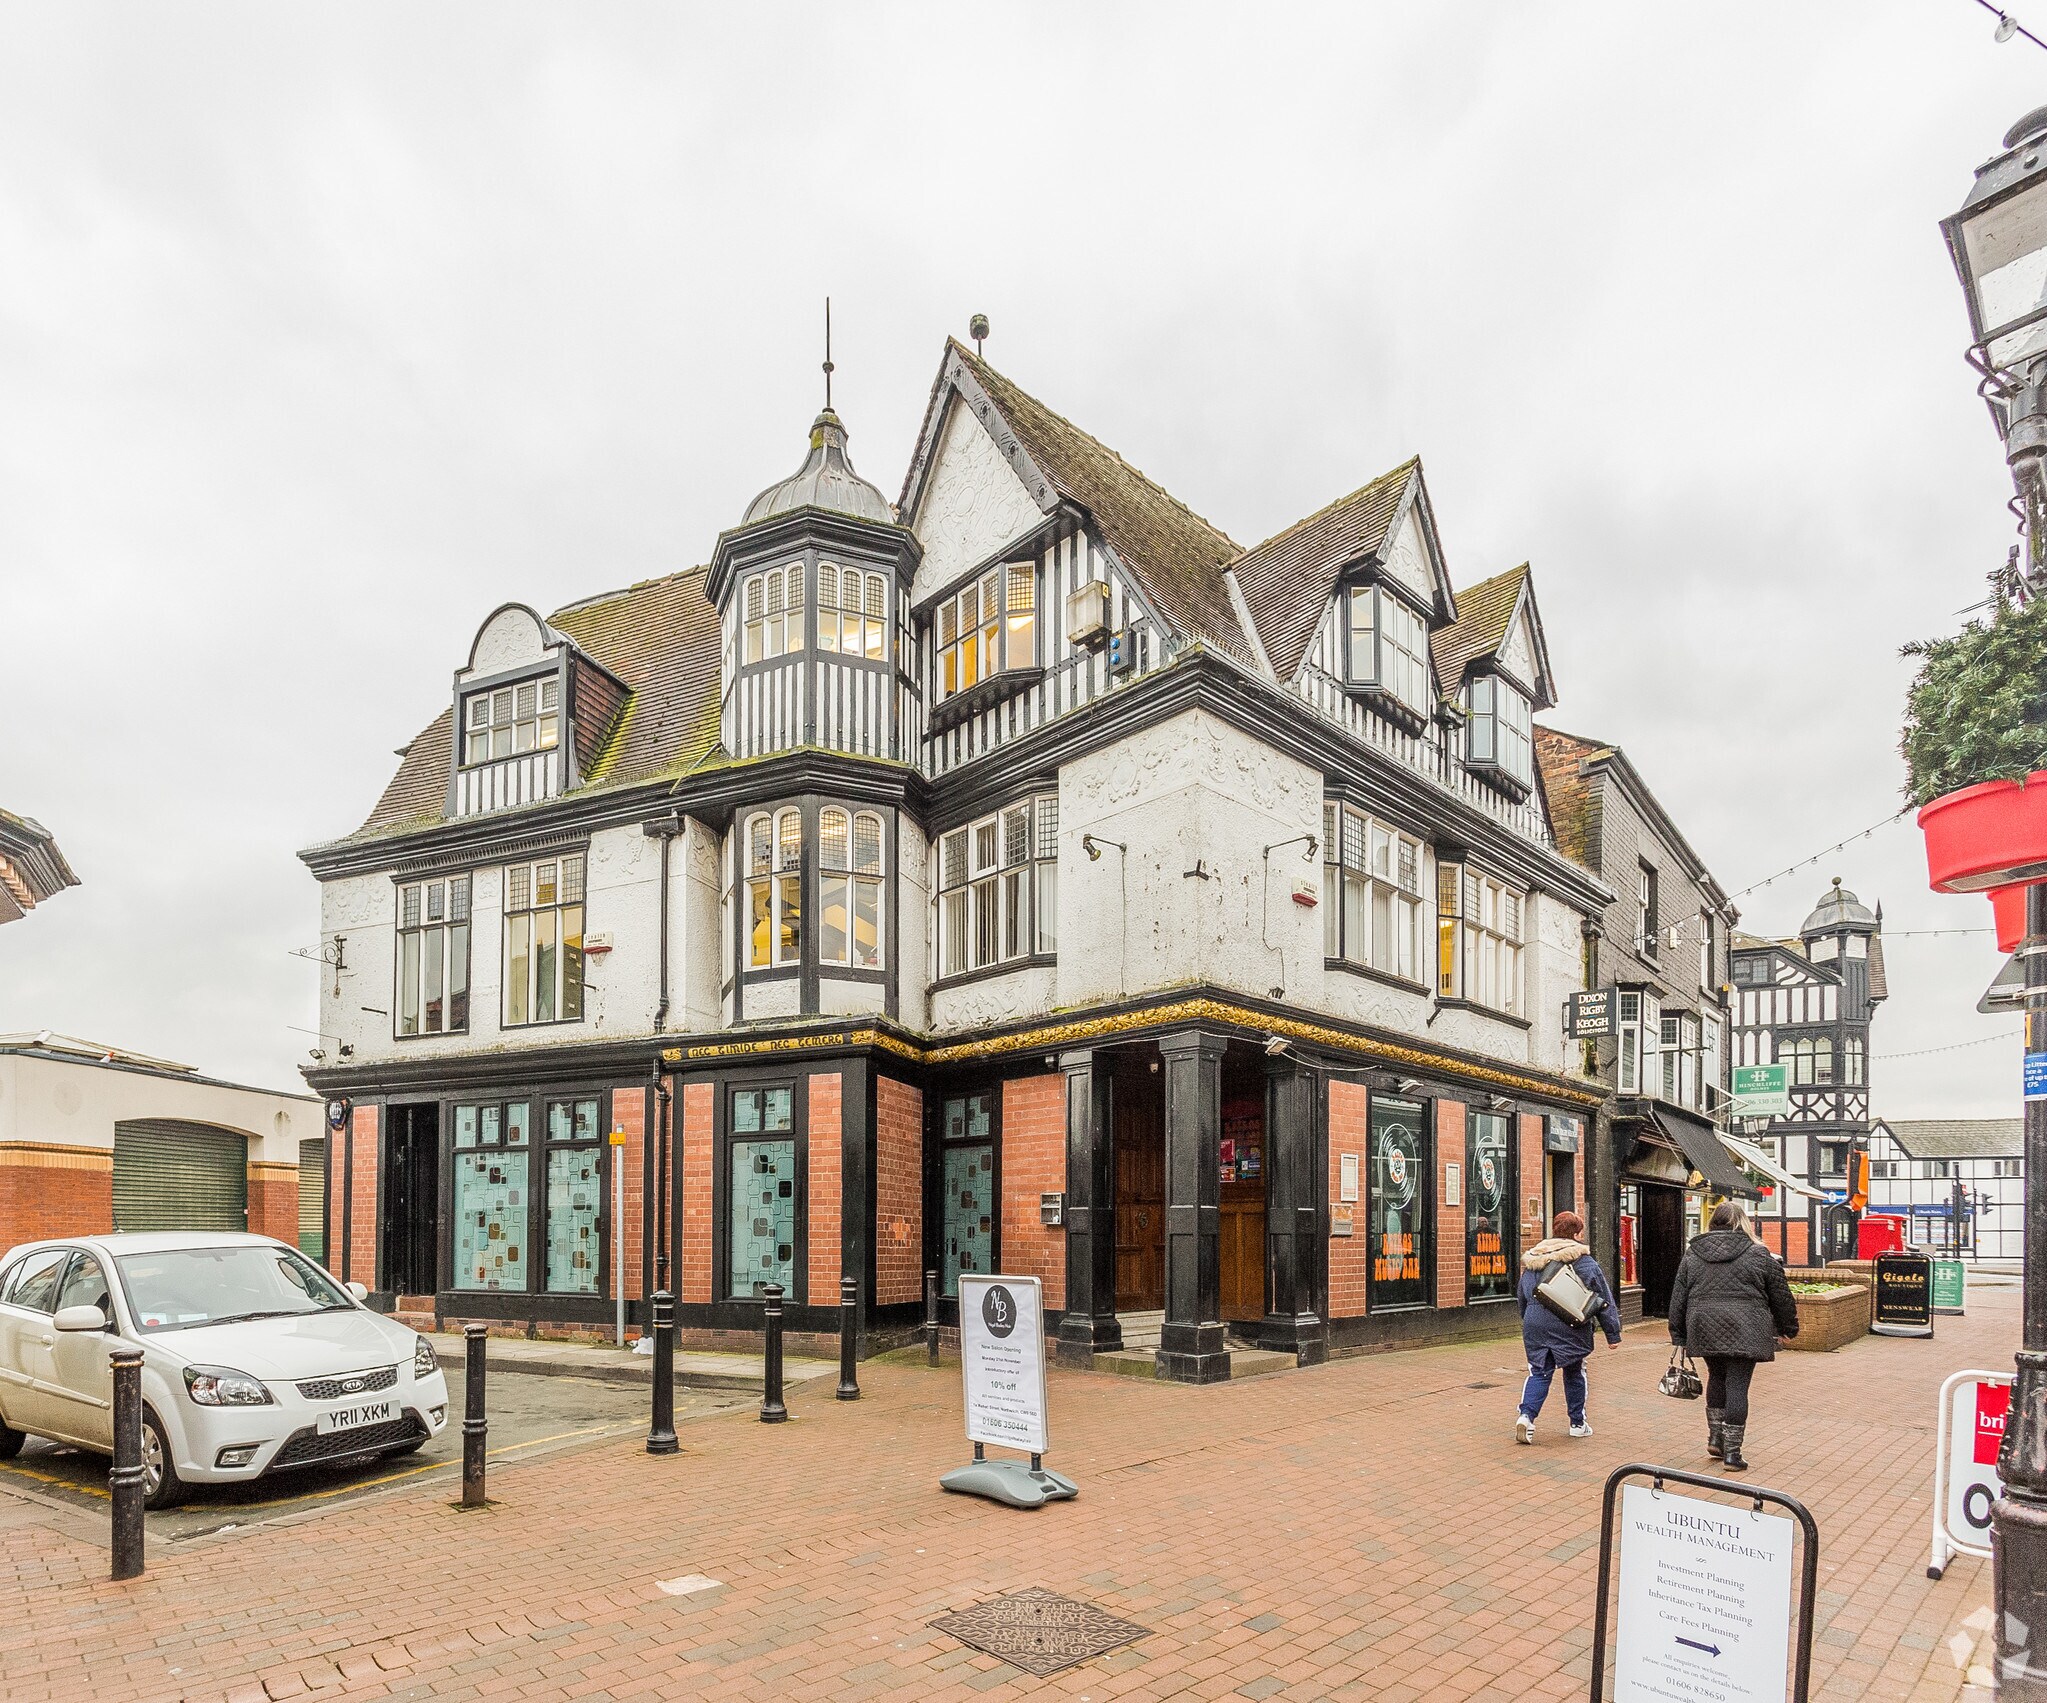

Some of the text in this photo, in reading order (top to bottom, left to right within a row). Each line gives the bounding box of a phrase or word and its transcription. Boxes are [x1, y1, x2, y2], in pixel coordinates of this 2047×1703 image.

[1579, 992, 1607, 1004] DIXON
[1579, 1005, 1606, 1016] RIGBY
[1576, 1017, 1609, 1029] KEOGH
[1577, 1027, 1608, 1035] SOLICITORS
[1883, 1272, 1924, 1282] Gigolo
[1004, 1346, 1021, 1354] Opening
[345, 1381, 360, 1389] KIA
[991, 1381, 1017, 1391] 10% off
[329, 1402, 390, 1428] YR11 XKM
[983, 1417, 1028, 1431] 01606 350444
[1667, 1511, 1741, 1540] UBUNTU
[1635, 1521, 1775, 1562] WEALTH MANAGEMENT
[1658, 1559, 1745, 1592] Investment Planning
[1657, 1575, 1745, 1608] Retirement Planning
[1648, 1589, 1753, 1627] Inheritance Tax Planning
[1658, 1610, 1740, 1642] Care Fees Planning
[993, 1644, 1061, 1652] CHIEFTAIN
[1663, 1653, 1672, 1661] All
[1673, 1656, 1700, 1669] enquiries
[1642, 1655, 1659, 1665] please
[1660, 1661, 1682, 1673] contact
[1700, 1673, 1709, 1681] the
[1711, 1677, 1731, 1689] details
[1666, 1676, 1726, 1702] 01606 828650
